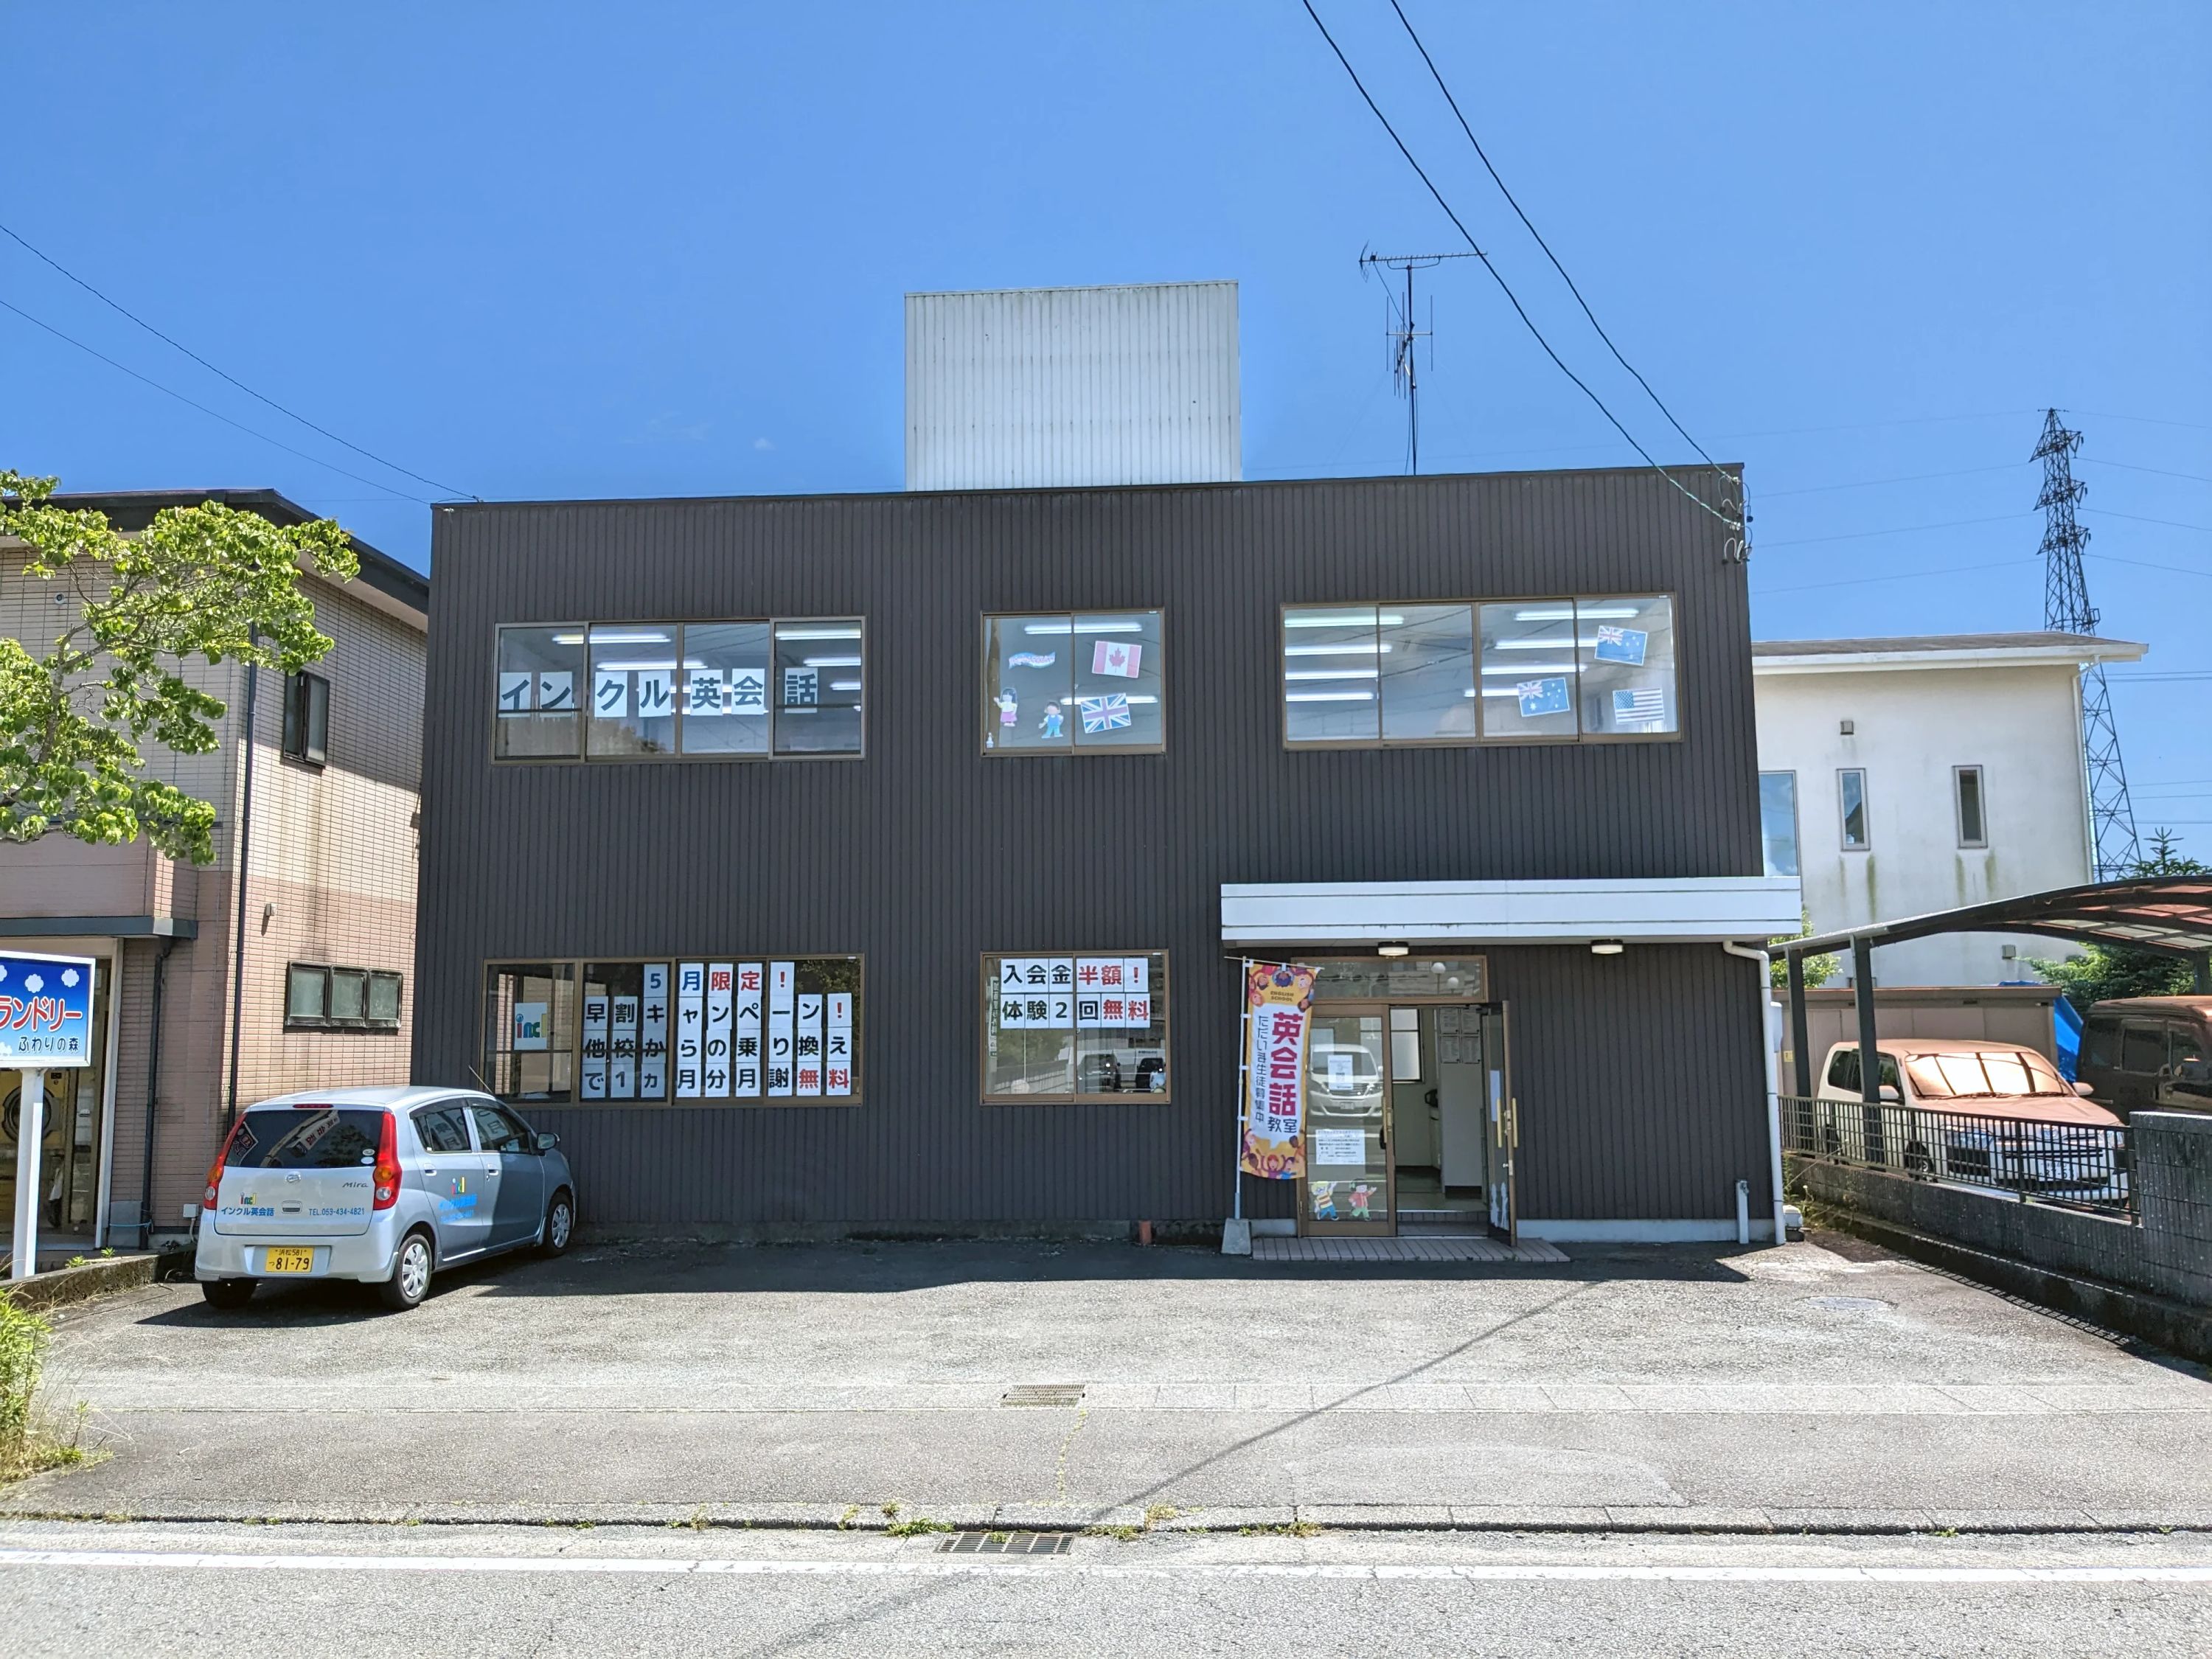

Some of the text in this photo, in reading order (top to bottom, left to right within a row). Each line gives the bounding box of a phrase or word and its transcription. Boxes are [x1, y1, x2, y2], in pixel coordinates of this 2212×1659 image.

[501, 675, 817, 709] インクル英会話
[1002, 1000, 1149, 1020] 体験2回無料
[18, 1036, 78, 1051] ふわりの森
[585, 1035, 847, 1058] 他校からの乗り換え
[221, 1208, 274, 1216] インクル英会話
